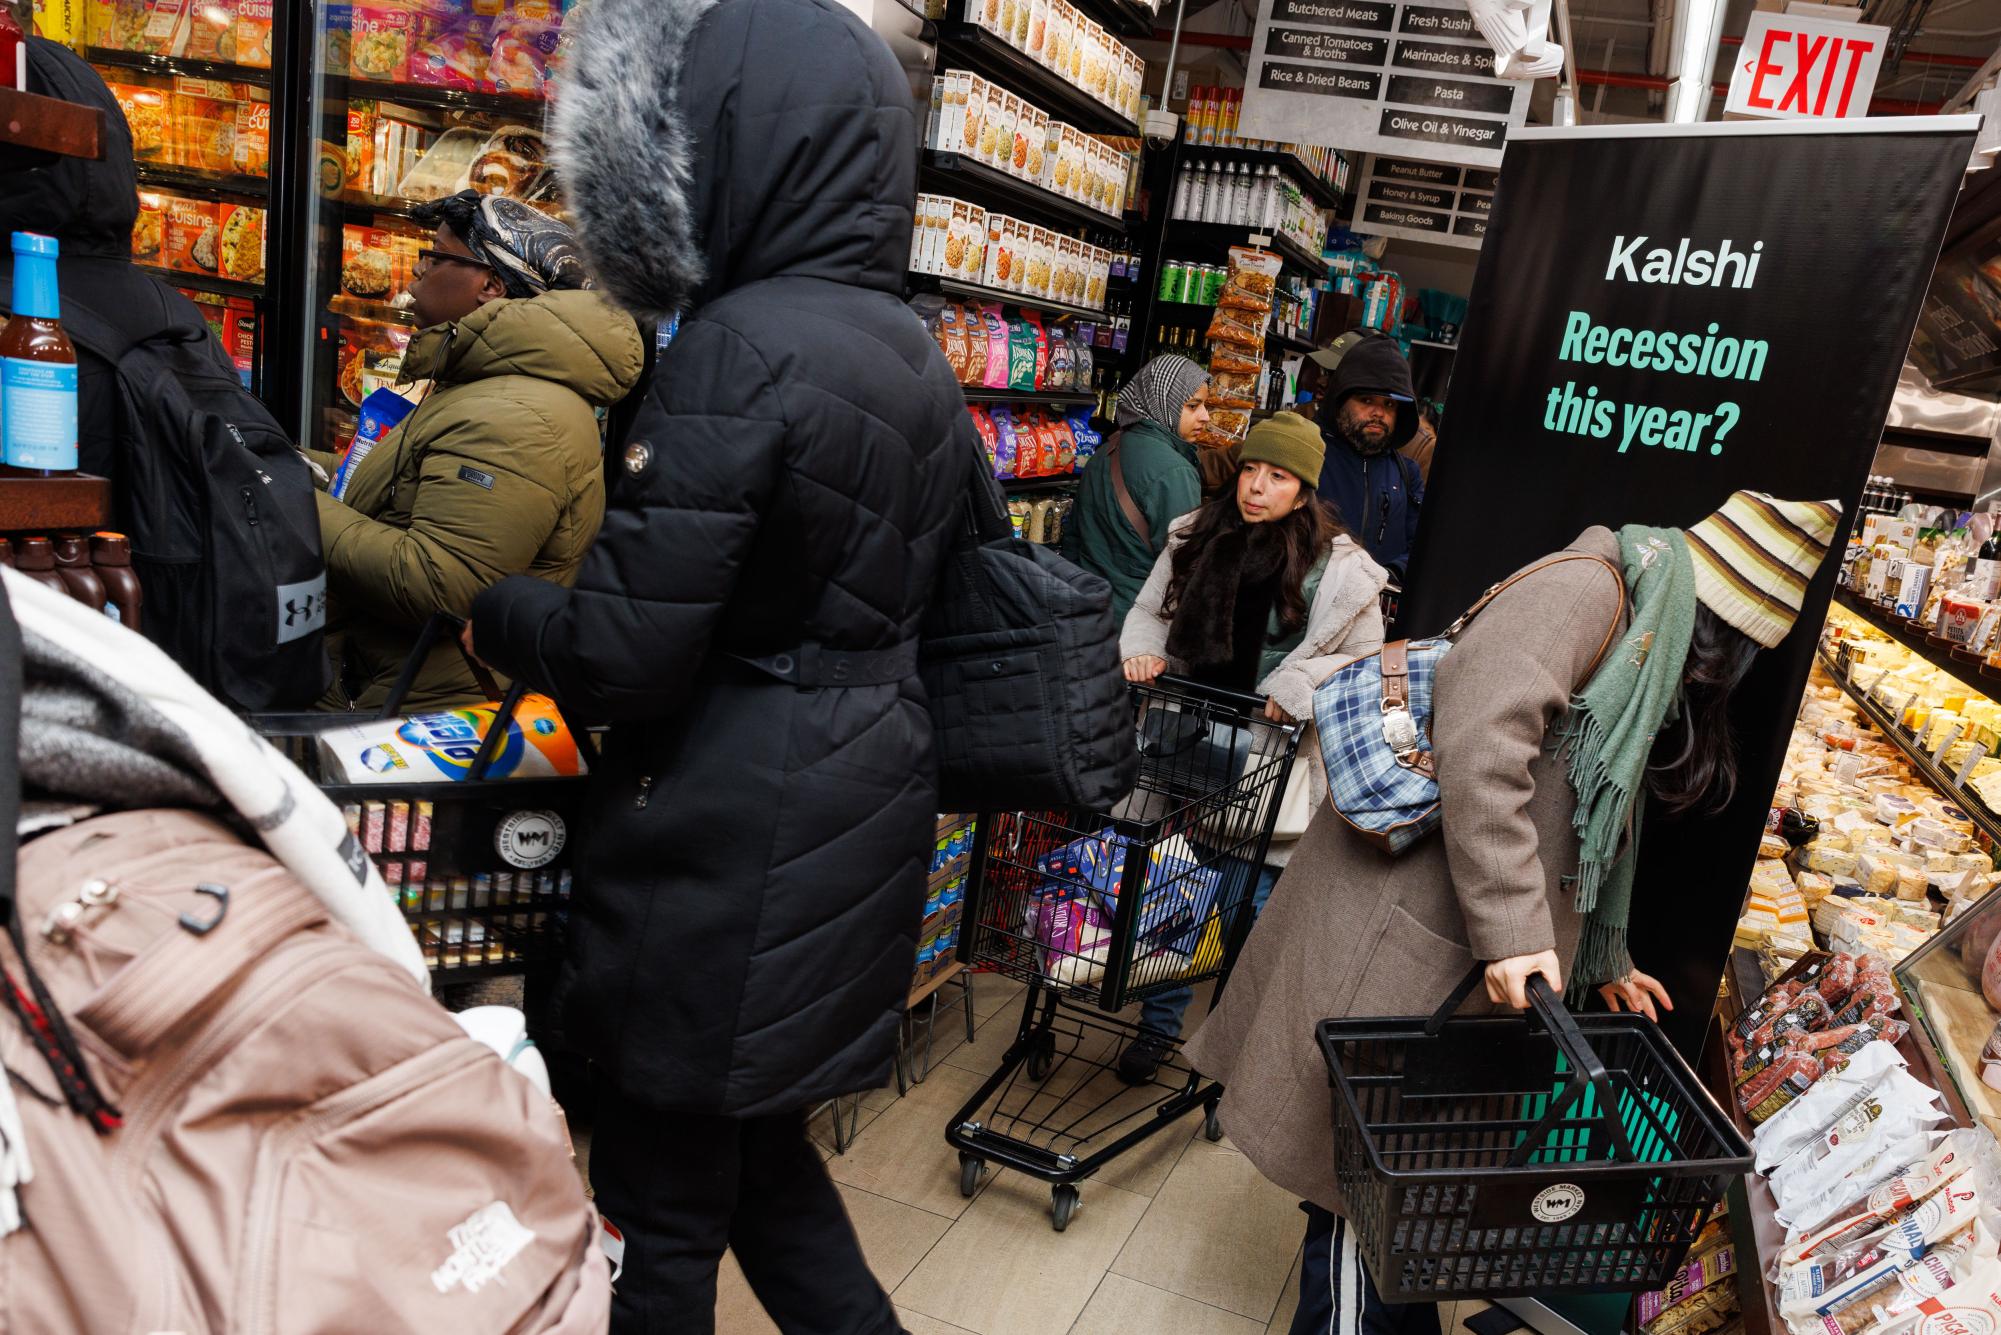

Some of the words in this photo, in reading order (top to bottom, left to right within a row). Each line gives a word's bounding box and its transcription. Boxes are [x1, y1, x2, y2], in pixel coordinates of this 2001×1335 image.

[1287, 2, 1345, 19] Butchered
[1346, 7, 1379, 22] Meats
[1408, 14, 1439, 29] Fresh
[1440, 17, 1472, 31] Sushi
[1281, 31, 1321, 46] Canned
[1323, 35, 1374, 52] Tomatoes
[1302, 45, 1312, 56] &
[1314, 46, 1348, 61] Broths
[1402, 48, 1460, 65] Marinades
[1461, 54, 1472, 66] &
[1270, 69, 1292, 83] Rice
[1295, 73, 1304, 84] &
[1306, 72, 1336, 87] Dried
[1338, 76, 1371, 90] Beans
[1746, 29, 1874, 119] EXIT
[1434, 86, 1464, 100] Pasta
[253, 105, 271, 118] Lea
[1391, 117, 1420, 131] Olive
[1421, 120, 1437, 133] Oil
[1440, 123, 1449, 134] &
[1452, 124, 1496, 141] Vinegar
[1390, 164, 1418, 176] Peanut
[1418, 167, 1443, 179] Butter
[1383, 187, 1409, 201] Honey
[1417, 192, 1440, 204] Syrup
[1476, 200, 1491, 210] Pea
[1380, 210, 1405, 223] Baking
[1406, 214, 1433, 226] Goods
[1605, 235, 1763, 289] Kalshi
[1558, 311, 1768, 382] Recession
[1544, 381, 1616, 439] this
[1616, 401, 1740, 455] year?
[517, 830, 550, 847] WM
[1533, 1186, 1556, 1214] WESTSIDE
[1559, 1184, 1583, 1199] MARKET
[1571, 1199, 1583, 1213] NYC
[1900, 1214, 1923, 1247] INAL
[1933, 1312, 1970, 1335] PICA
